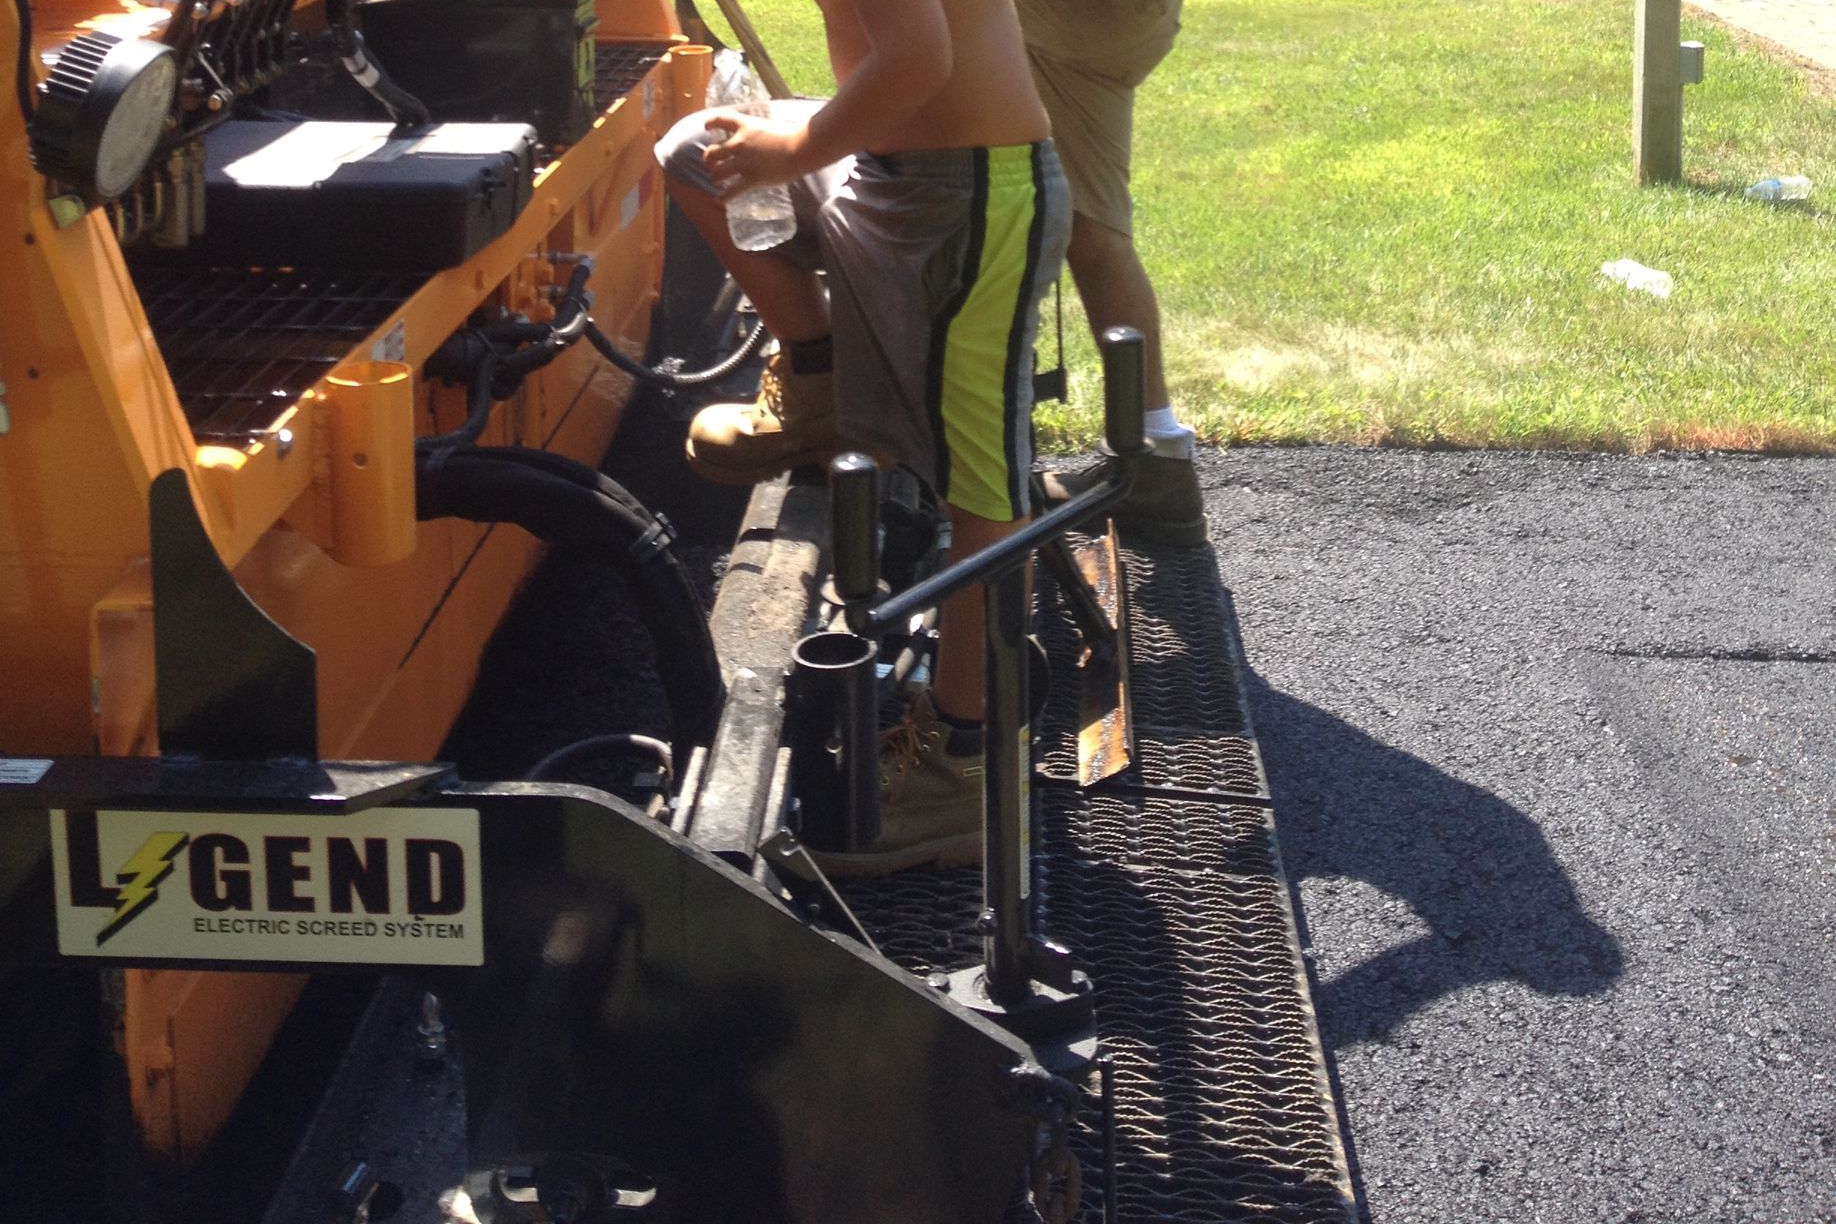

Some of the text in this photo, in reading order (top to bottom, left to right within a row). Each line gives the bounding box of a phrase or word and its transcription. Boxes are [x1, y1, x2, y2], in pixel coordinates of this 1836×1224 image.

[65, 809, 467, 918] LGEND
[193, 917, 465, 939] ELECTRIC SCREED SYSTEM
